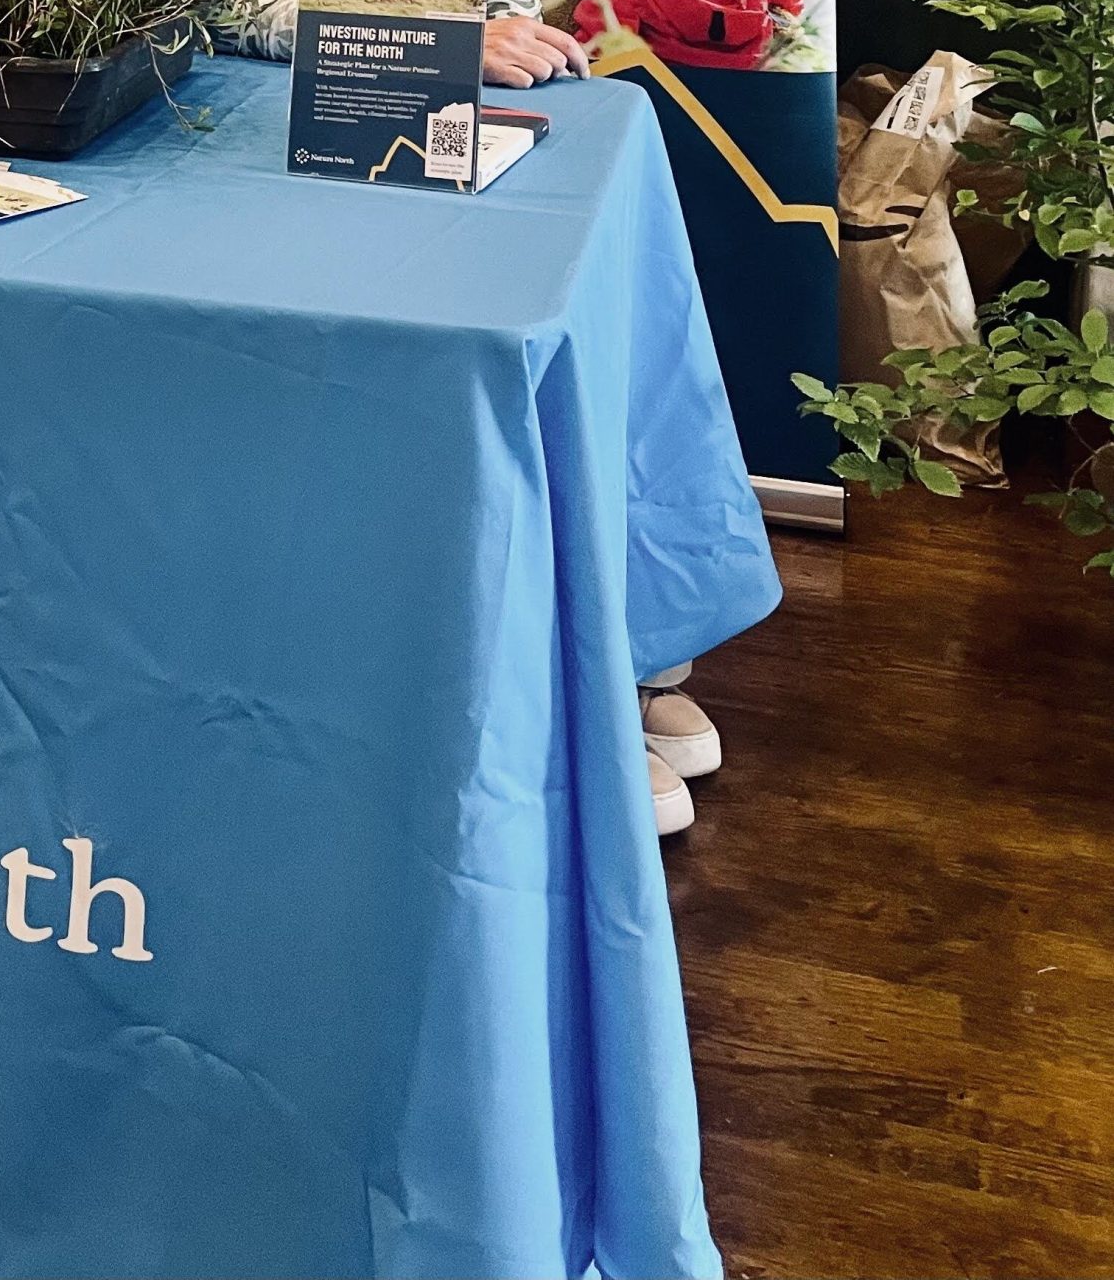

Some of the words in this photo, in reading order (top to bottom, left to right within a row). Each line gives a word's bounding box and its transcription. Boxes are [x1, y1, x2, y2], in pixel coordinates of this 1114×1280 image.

[319, 24, 376, 41] INVESTING
[378, 28, 390, 43] IN
[391, 29, 436, 46] NATURE
[318, 40, 340, 55] FOR
[342, 42, 364, 57] THE
[366, 44, 404, 60] NORTH
